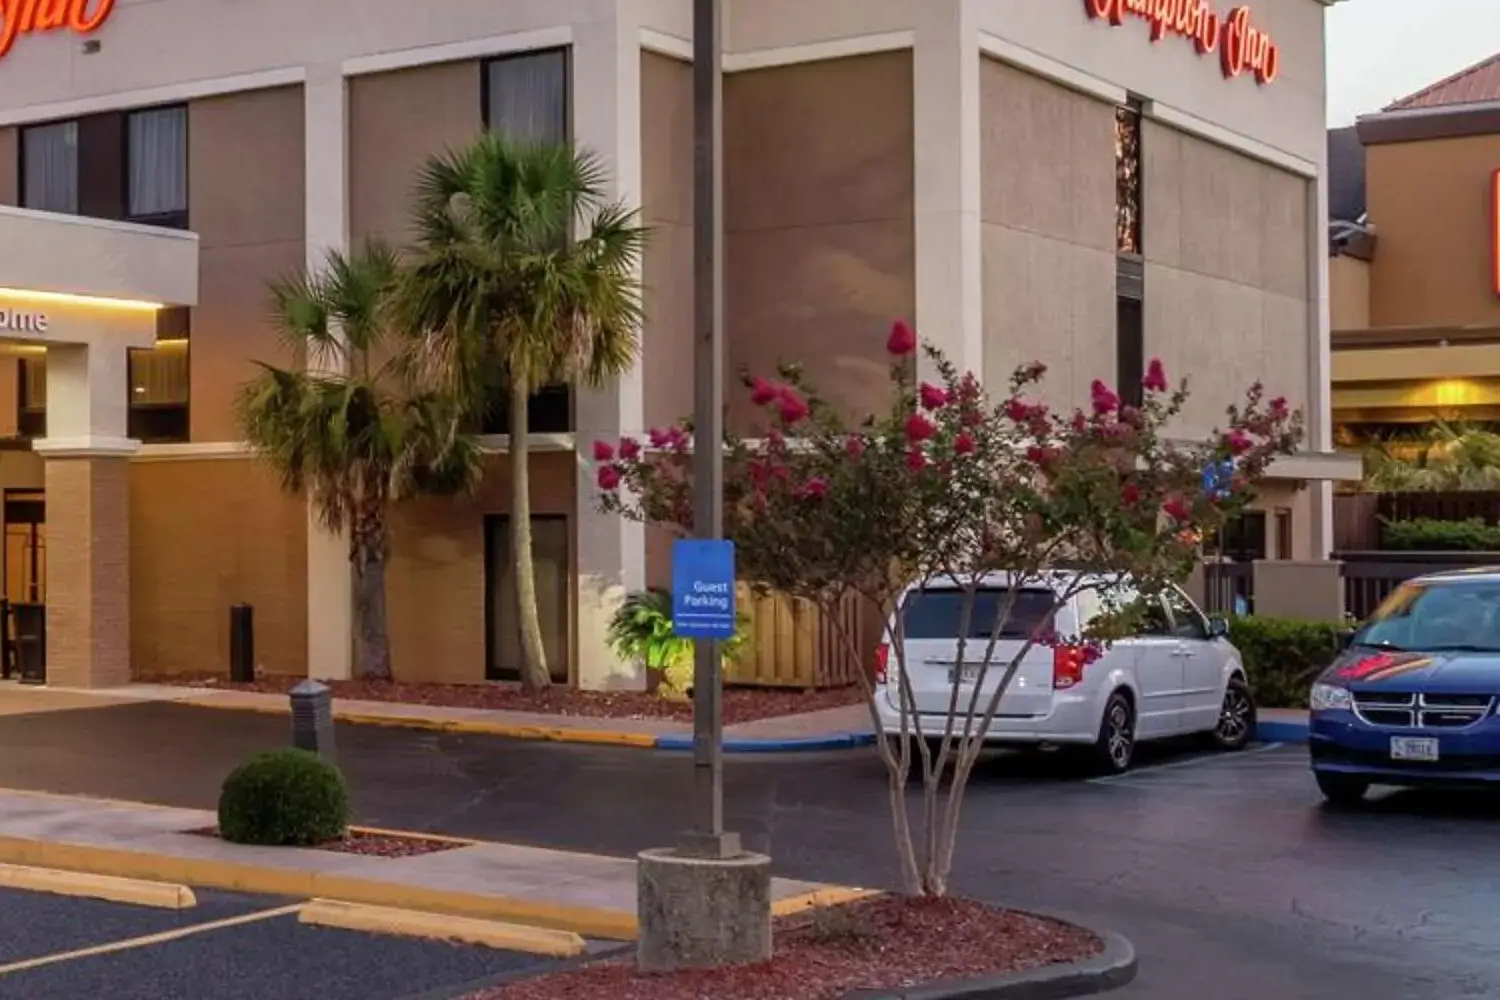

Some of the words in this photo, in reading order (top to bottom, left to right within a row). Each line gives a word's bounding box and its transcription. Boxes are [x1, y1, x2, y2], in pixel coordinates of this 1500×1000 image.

[1220, 4, 1278, 85] Inn
[693, 581, 728, 593] Guest
[683, 594, 728, 610] Parking
